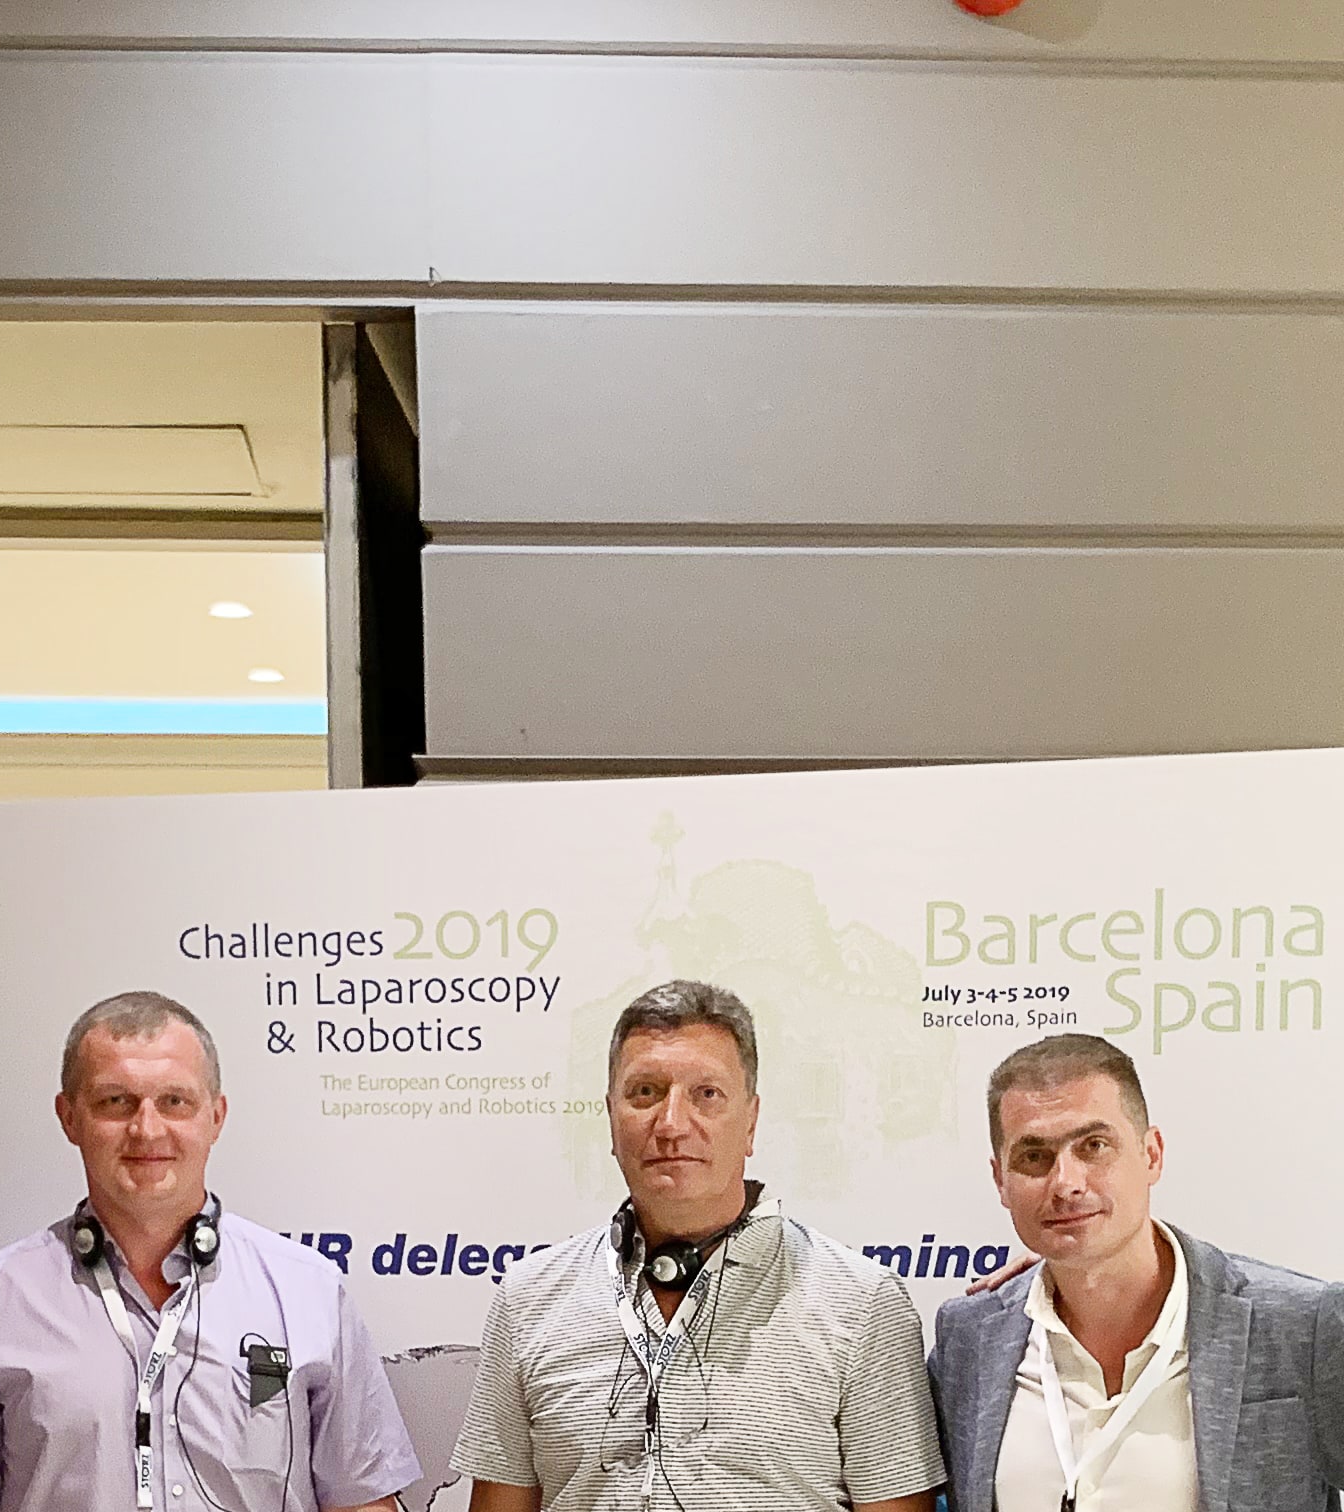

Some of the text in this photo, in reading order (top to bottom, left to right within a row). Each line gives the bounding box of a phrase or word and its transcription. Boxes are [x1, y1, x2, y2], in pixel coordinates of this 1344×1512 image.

[179, 908, 559, 973] Challenges 2019
[925, 887, 1324, 967] Barcelona
[265, 973, 560, 1014] in Laparoscopy
[922, 984, 1070, 1004] July 3-4-5 2019
[1103, 962, 1323, 1056] Spain
[267, 1018, 482, 1053] & Robotics
[923, 1008, 1077, 1029] Barcelona, Spain
[321, 1072, 552, 1095] The European Congress of
[321, 1098, 605, 1120] Laparoscopy and Robotics 2019
[862, 1234, 1010, 1283] ming
